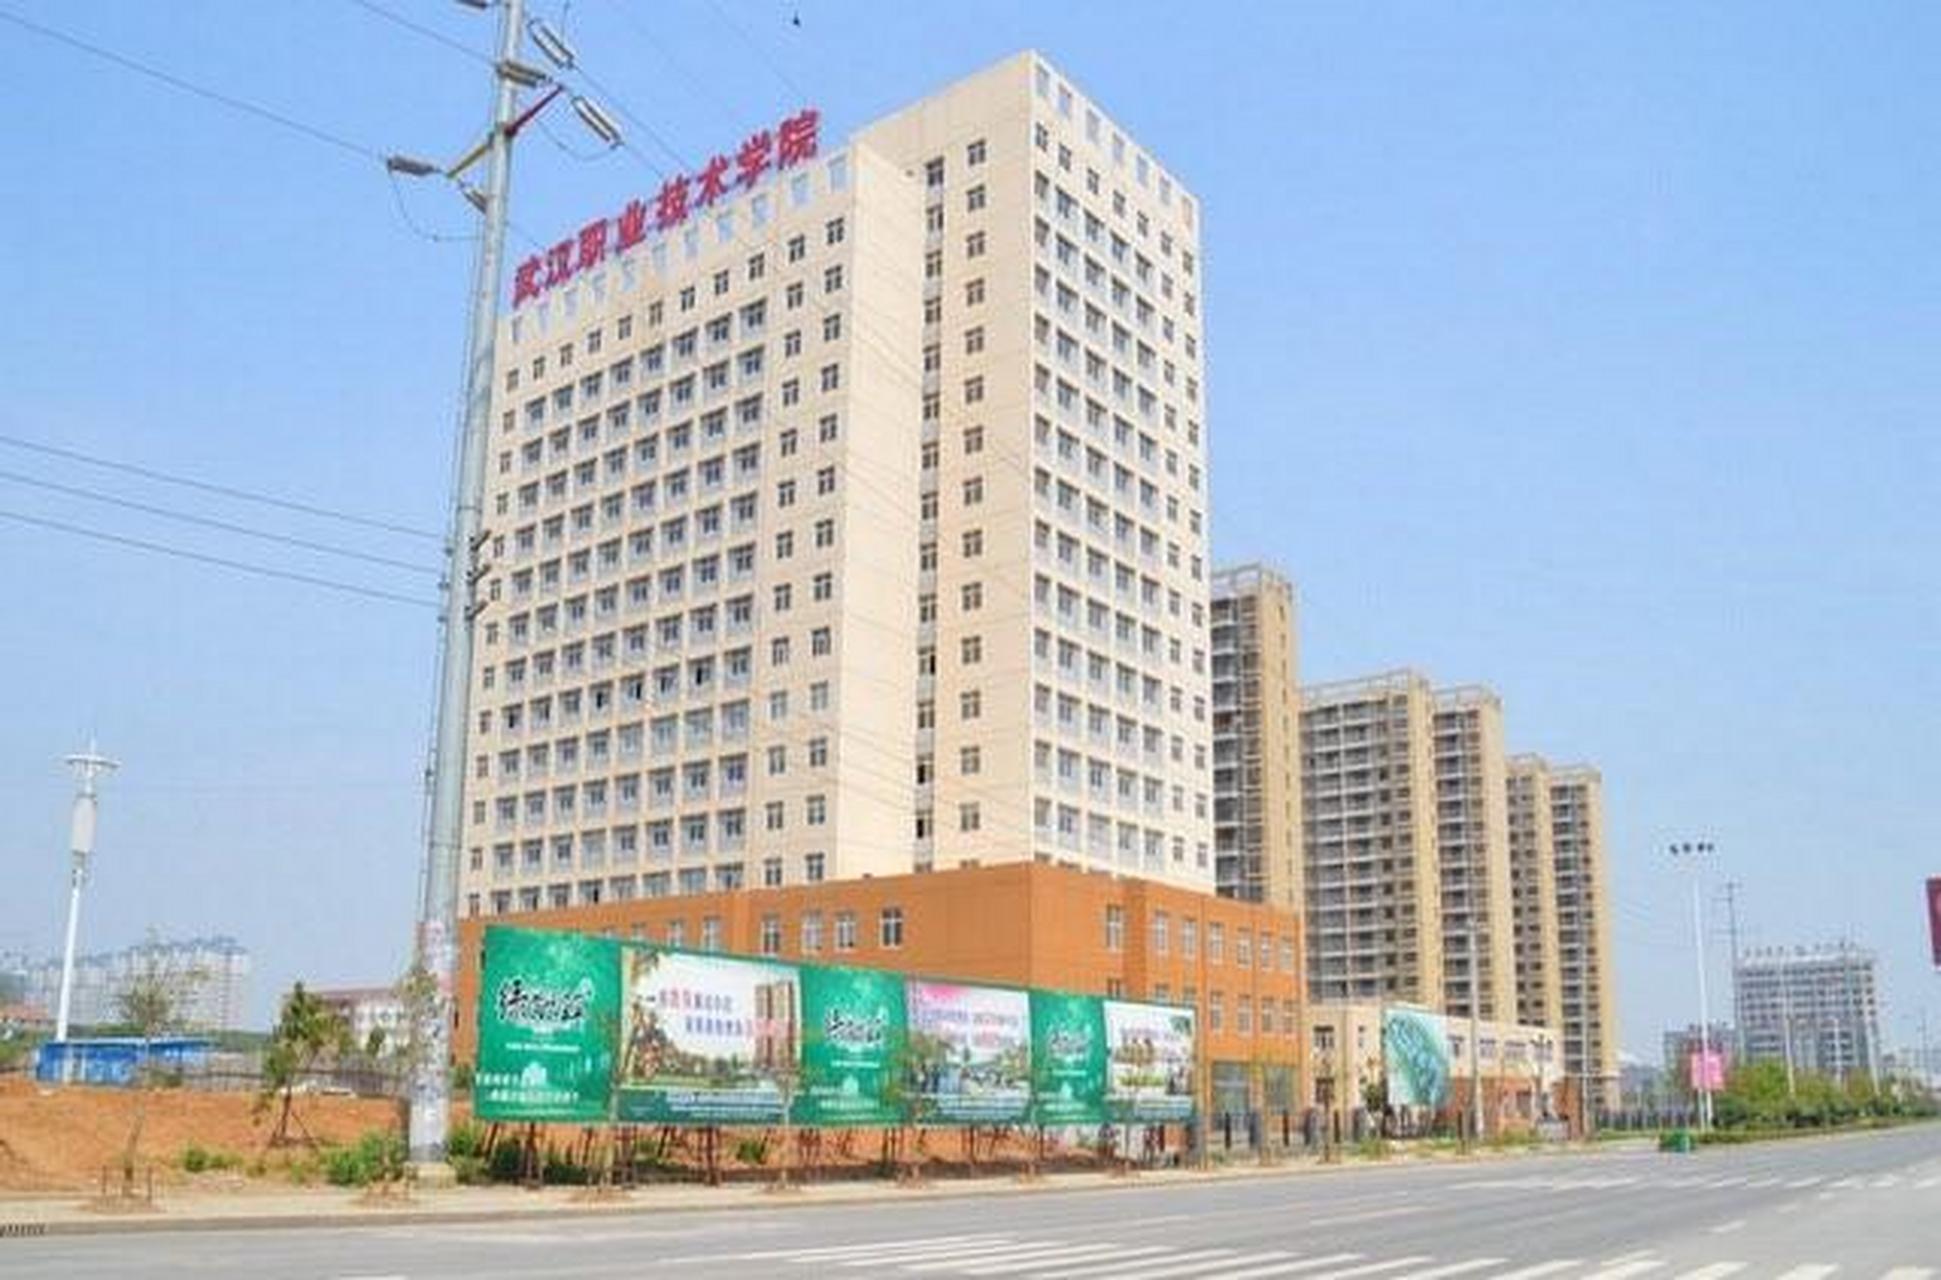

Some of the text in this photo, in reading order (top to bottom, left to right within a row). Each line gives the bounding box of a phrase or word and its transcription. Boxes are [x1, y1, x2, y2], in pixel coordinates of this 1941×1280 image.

[513, 109, 820, 306] 武汉职业技术学院
